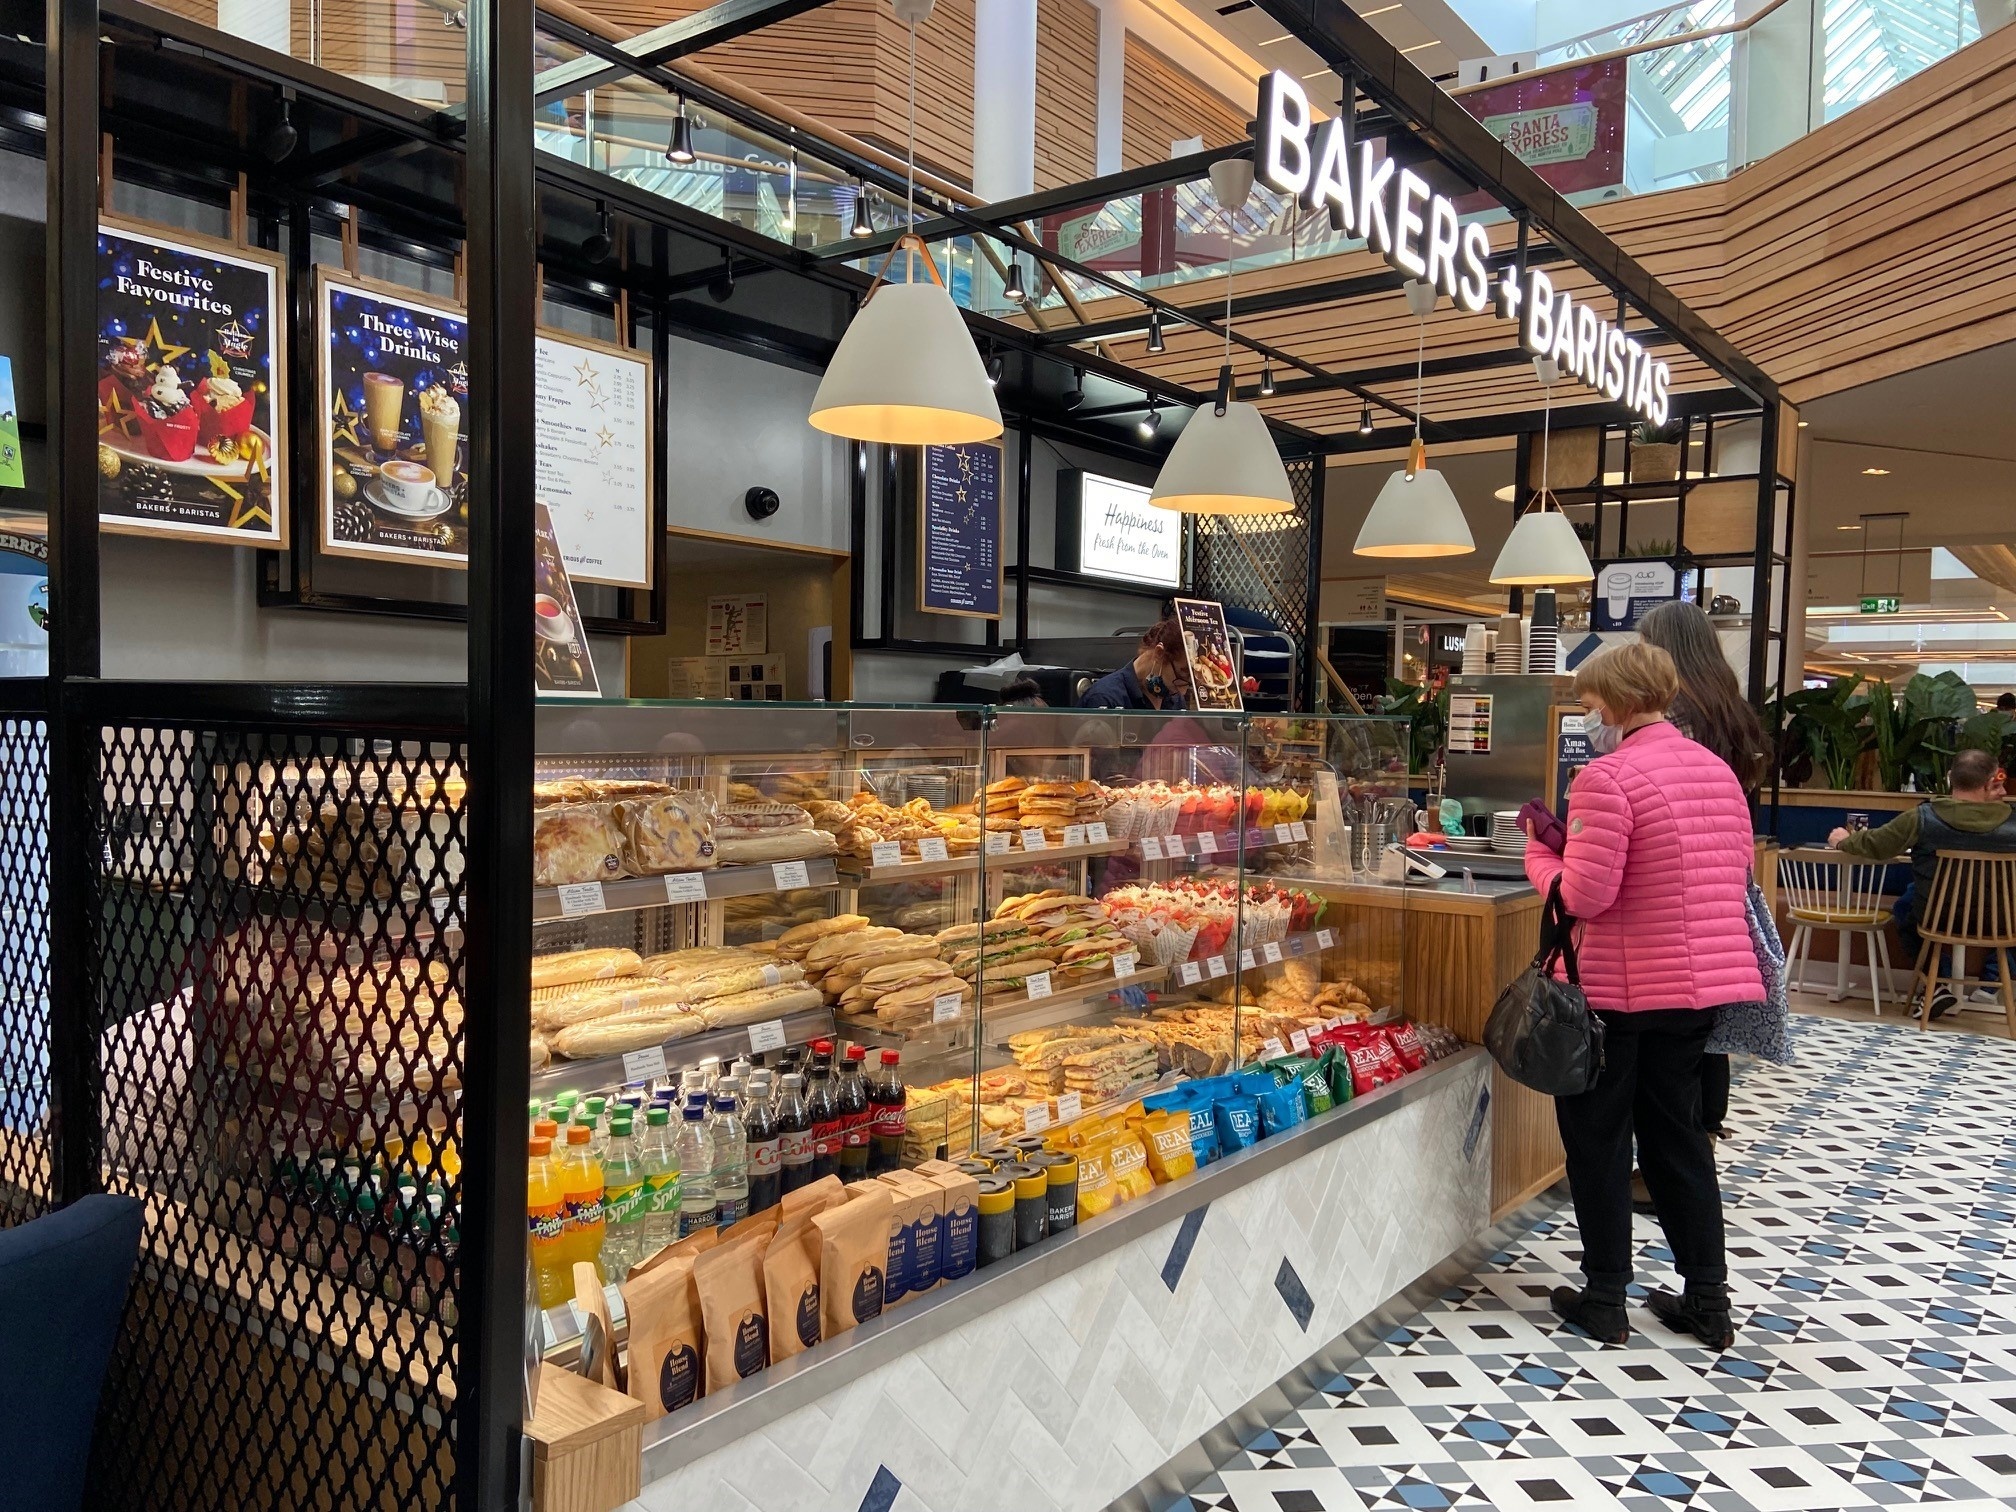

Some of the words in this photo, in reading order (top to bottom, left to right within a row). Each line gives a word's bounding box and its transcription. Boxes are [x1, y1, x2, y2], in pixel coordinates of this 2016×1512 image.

[1510, 113, 1560, 140] SANTA
[1511, 126, 1569, 154] XPRESS
[743, 154, 791, 177] Coo
[1265, 69, 1490, 311] BAKERS
[1503, 265, 1521, 318] +
[1529, 270, 1670, 426] BARISTAS
[137, 259, 214, 292] Festive
[117, 275, 233, 316] Favourites
[359, 312, 412, 339] Three
[417, 326, 459, 350] Wise
[380, 336, 441, 364] Drinks
[548, 395, 572, 406] Frappes
[541, 418, 572, 430] Smoothies
[535, 443, 558, 451] shakes
[539, 485, 572, 495] Lemonades
[136, 502, 170, 513] BAKERS
[179, 507, 220, 518] BARISTAS
[1105, 503, 1164, 535] Happiness
[0, 533, 48, 558] ERRY'S
[380, 532, 406, 541] BAKERS
[413, 536, 445, 546] BARISTAS
[1152, 543, 1168, 559] Oven
[563, 555, 579, 563] ERIOUS
[1861, 602, 1876, 610] Exit
[1444, 635, 1465, 651] LUSH
[1354, 693, 1372, 701] pen
[1564, 738, 1586, 747] Xmas
[1190, 1112, 1213, 1131] EAL
[1156, 1128, 1191, 1151] REAL
[1162, 1147, 1192, 1161] HANDCOOK
[1079, 1160, 1105, 1181] EAL
[688, 1211, 716, 1225] HARROG
[950, 1217, 972, 1228] House
[916, 1226, 938, 1238] House
[951, 1223, 972, 1237] Blend
[890, 1238, 906, 1248] ouse
[916, 1233, 937, 1247] Blend
[889, 1245, 905, 1257] lend
[670, 1354, 688, 1368] House
[671, 1361, 688, 1376] Blend
